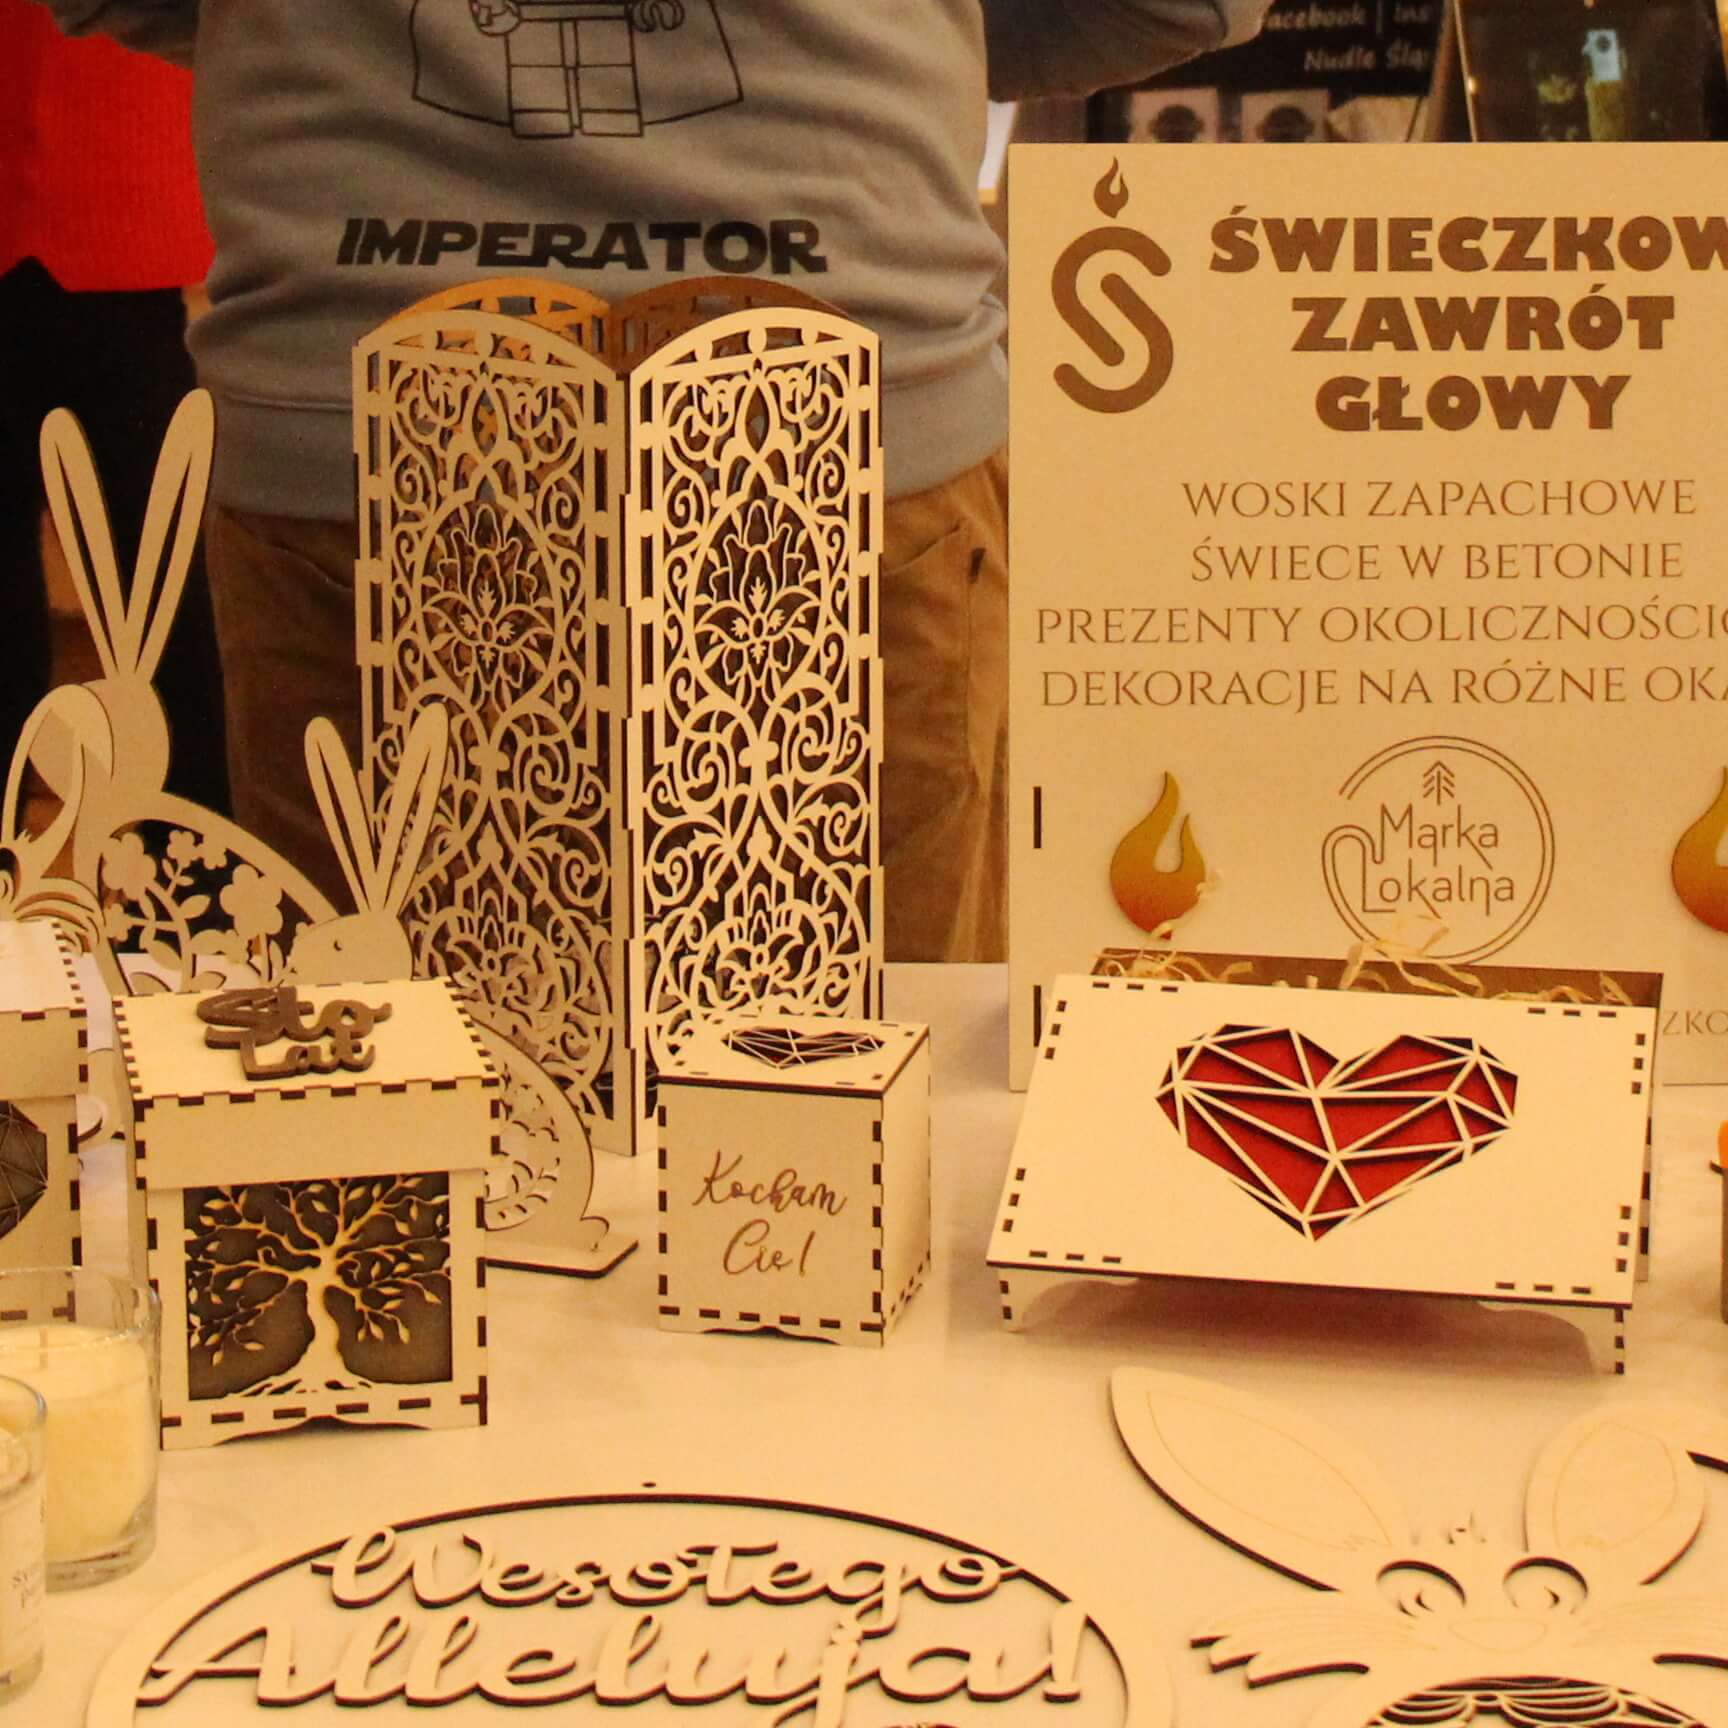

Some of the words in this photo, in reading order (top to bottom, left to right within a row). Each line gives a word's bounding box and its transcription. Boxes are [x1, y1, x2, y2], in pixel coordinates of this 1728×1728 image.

[335, 217, 828, 274] IMPERATOR
[1292, 282, 1675, 353] ZAWRÓT
[1315, 374, 1632, 431] GŁOWY
[1181, 479, 1347, 517] WOSKI
[1367, 477, 1698, 516] ZAPACHOWE
[1190, 537, 1381, 583] ŚWIECE
[1397, 543, 1450, 580] W
[1464, 542, 1684, 579] BETONIE
[1035, 606, 1303, 645] PREZENTY
[1041, 667, 1339, 714] DEKORACJE
[1357, 669, 1433, 706] NA
[1452, 658, 1626, 706] RÓŻNE
[1380, 802, 1499, 872] Marka
[1361, 856, 1516, 919] Lokalna
[196, 986, 392, 1049] Sto
[240, 1030, 376, 1081] Lat
[691, 1149, 849, 1216] Kocham
